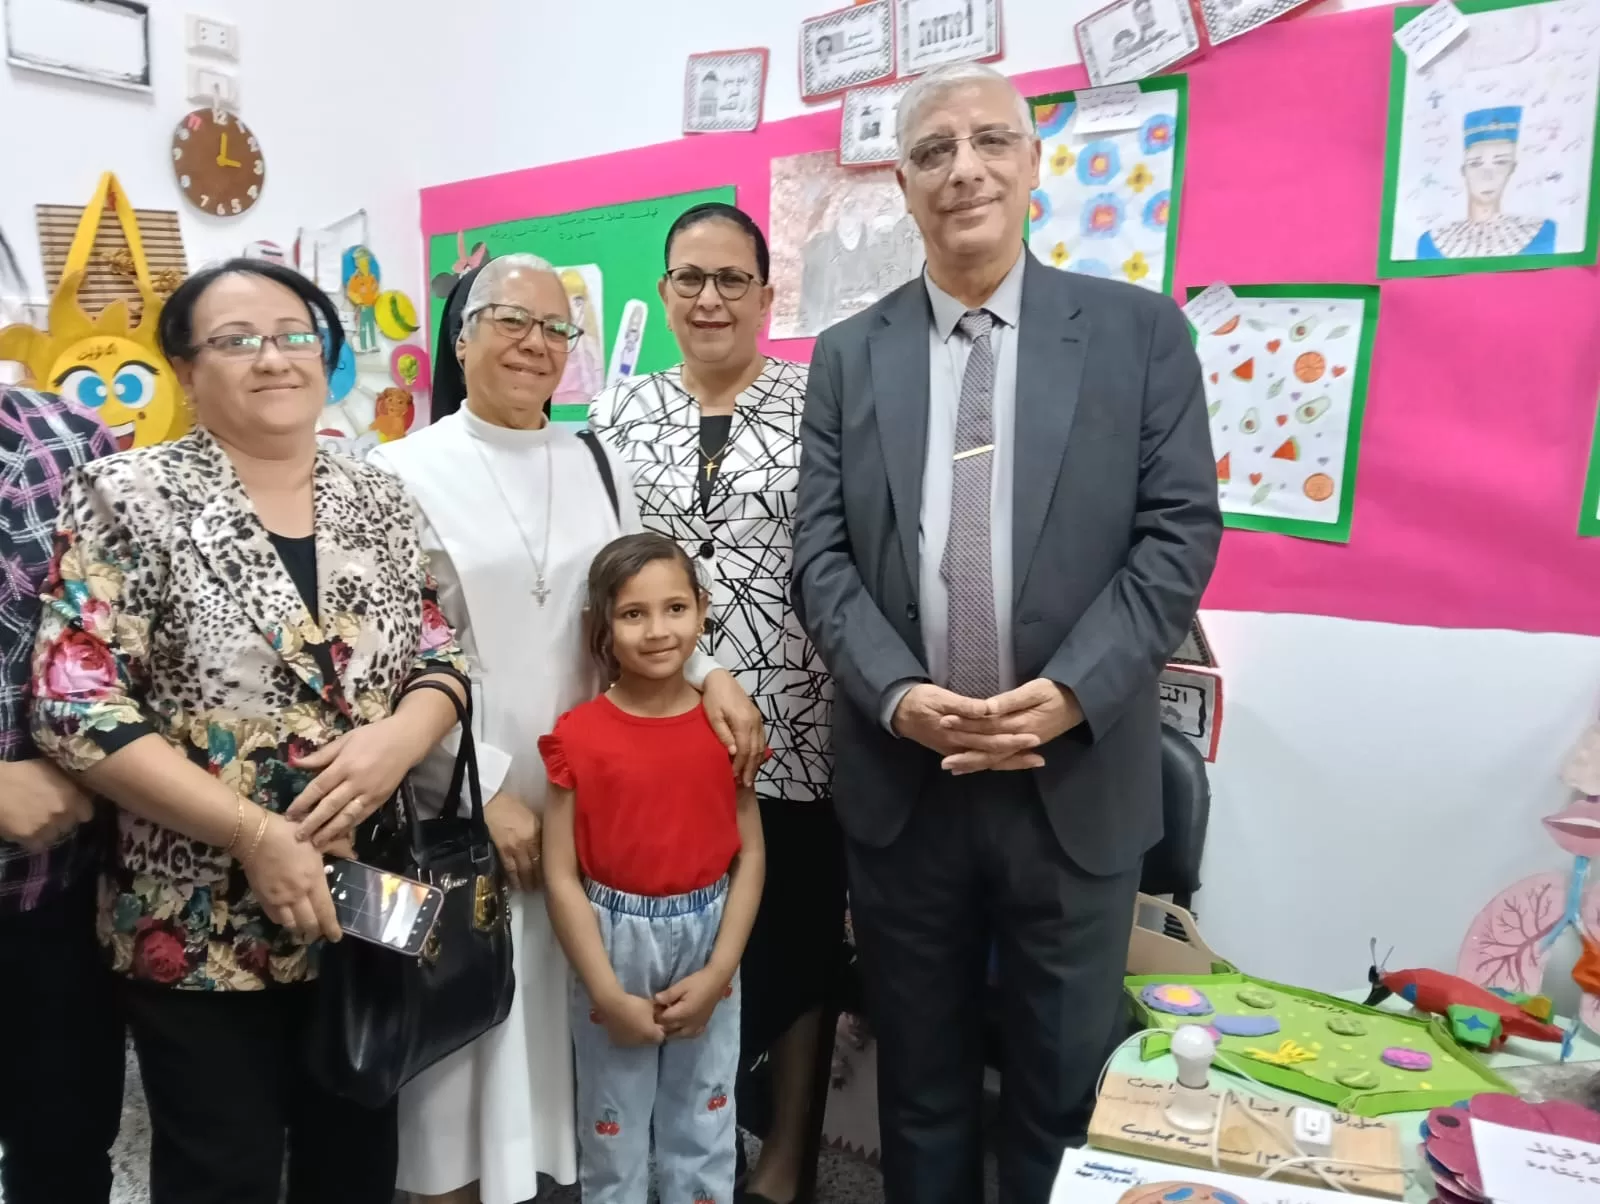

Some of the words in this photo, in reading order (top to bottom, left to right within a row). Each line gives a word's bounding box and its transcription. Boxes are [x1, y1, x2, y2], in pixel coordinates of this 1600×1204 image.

[212, 108, 228, 125] 12
[247, 136, 259, 152] 2
[173, 147, 183, 160] 9
[253, 159, 263, 175] 3
[180, 174, 191, 188] 8
[246, 185, 258, 199] 4
[200, 194, 209, 207] 7
[231, 198, 242, 213] 5
[217, 203, 226, 215] 6
